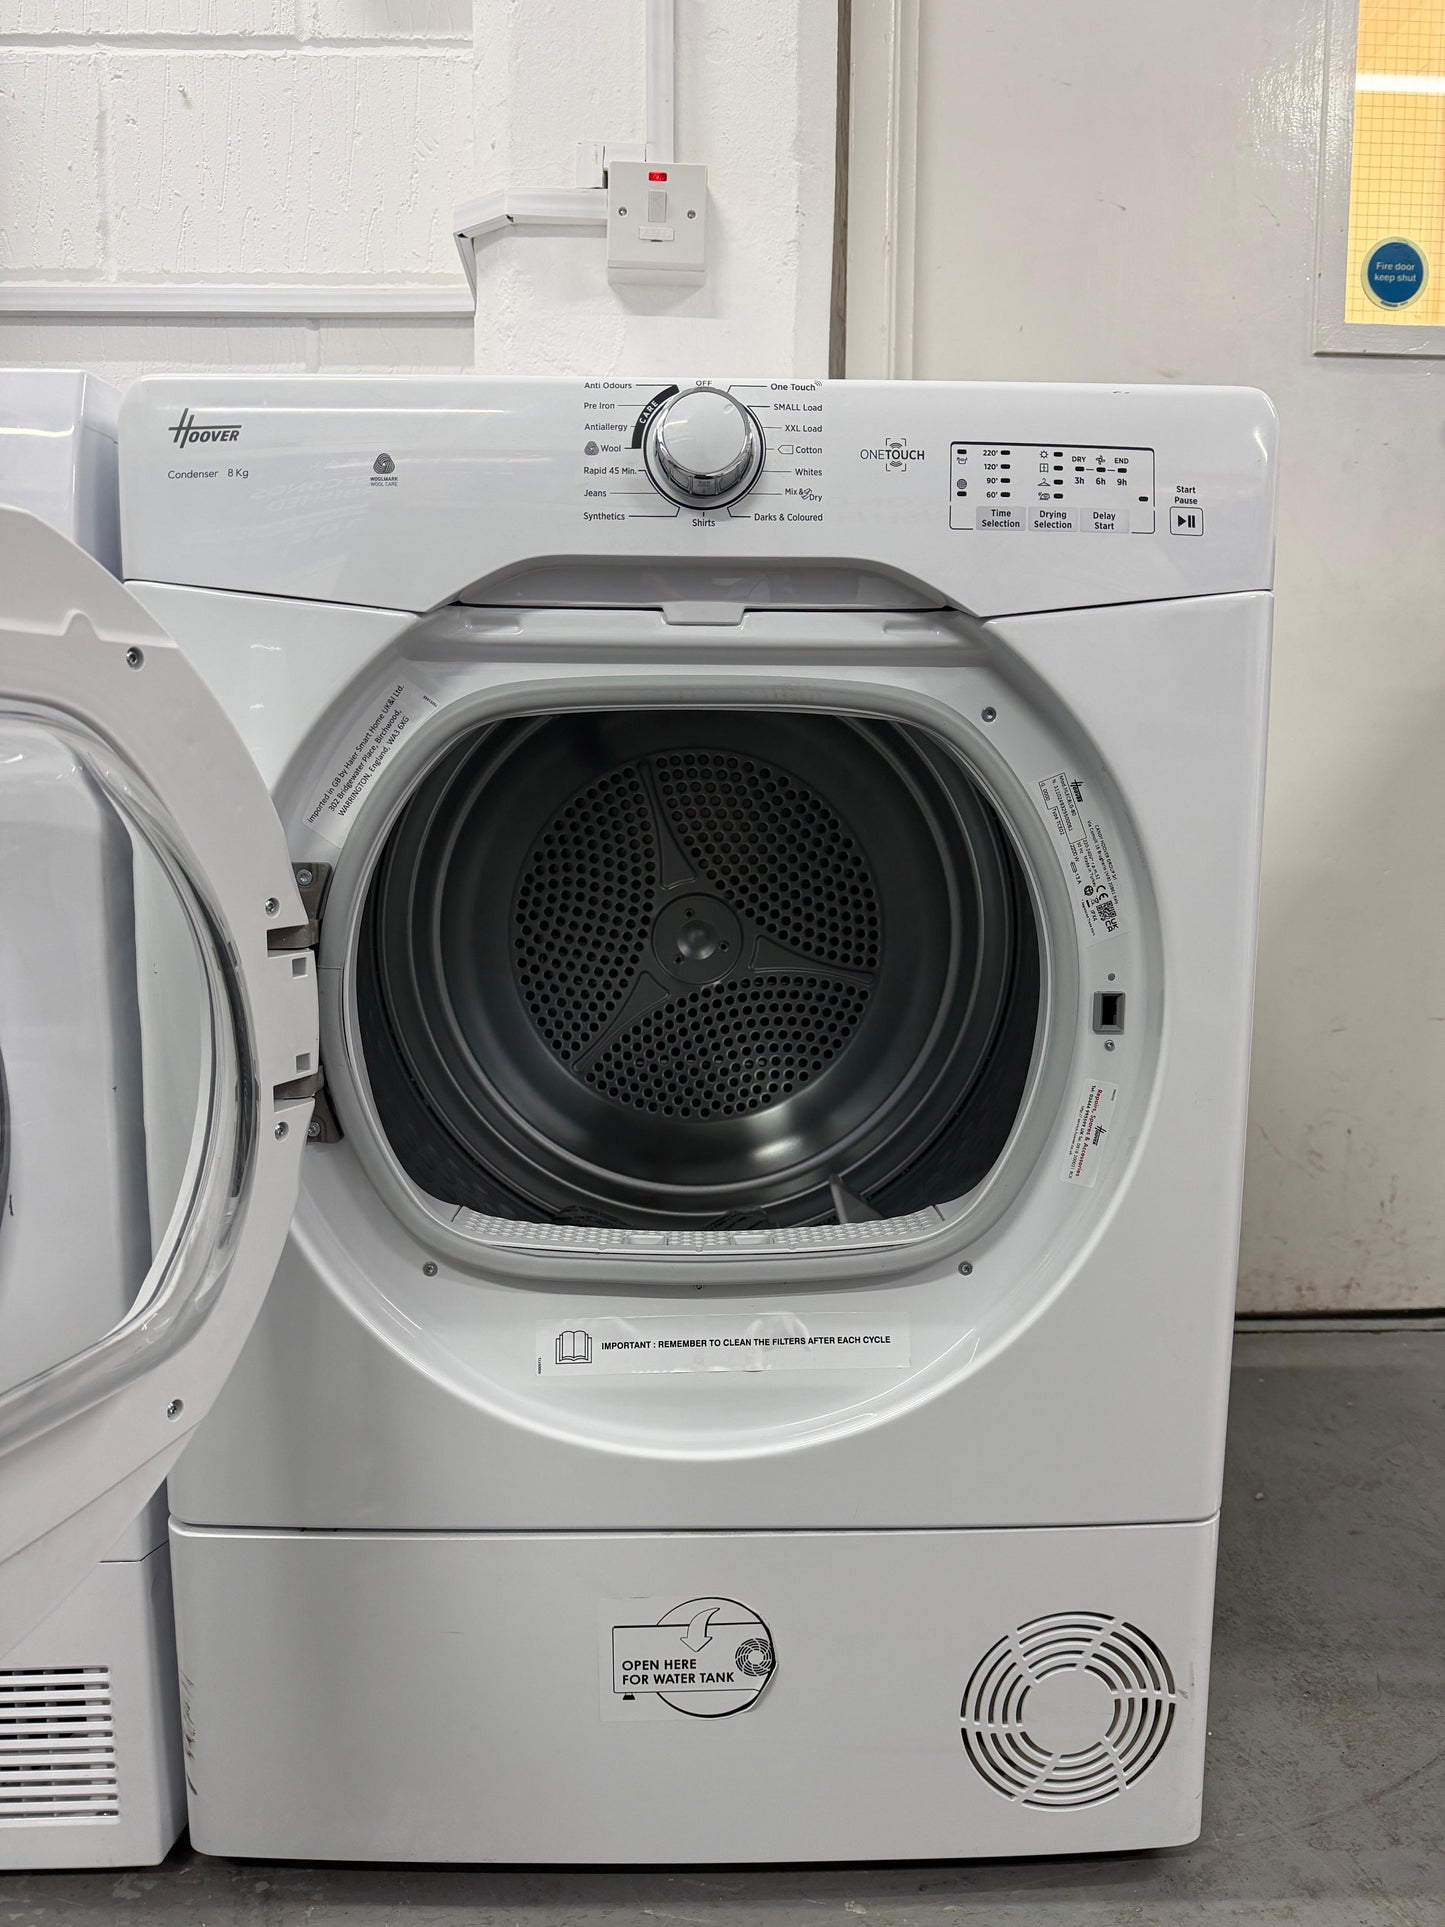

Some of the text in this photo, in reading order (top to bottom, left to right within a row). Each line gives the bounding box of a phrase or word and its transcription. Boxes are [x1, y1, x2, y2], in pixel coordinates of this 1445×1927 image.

[1376, 262, 1415, 271] Fire door
[1374, 273, 1416, 283] keep shut
[770, 383, 816, 392] One Touch
[640, 400, 658, 424] CARE
[168, 408, 242, 448] HOOVER
[584, 423, 628, 432] Antiallergy
[600, 444, 622, 452] Wool
[796, 446, 822, 454] Cotton
[860, 449, 925, 460] ONETOUCH
[168, 468, 249, 480] Condenser 8 Kg
[584, 466, 606, 475] Rapid
[794, 468, 822, 476] Whites
[1074, 476, 1128, 486] 3h 6h 9h
[584, 490, 607, 498] Jeans
[1176, 486, 1196, 494] Start
[809, 494, 822, 502] Dry
[1174, 496, 1198, 505] Pause
[584, 512, 626, 520] Synthetics
[787, 514, 823, 522] Coloured
[990, 508, 1012, 518] Time
[1039, 510, 1067, 520] Drying
[1092, 512, 1116, 521] Delay
[692, 518, 716, 526] Shirts
[982, 520, 1020, 528] Selection
[1034, 520, 1072, 530] Selection
[1094, 522, 1114, 530] Start
[306, 684, 405, 823] Imported in GB by Haier Smart Home UK&I Ltd.
[328, 710, 402, 812] 302 Bridgewater Place, Birchwood,
[338, 716, 410, 817] WARRINGTON, England, WA3 6XG
[1096, 885, 1108, 900] CE
[1085, 1114, 1096, 1136] Spares
[1075, 1143, 1089, 1177] Accessories
[602, 1340, 652, 1350] IMPORTANT
[658, 1340, 707, 1348] REMEMBER
[708, 1339, 721, 1347] TO
[722, 1338, 752, 1347] CLEAN
[754, 1338, 770, 1346] THE
[772, 1337, 806, 1346] FILTERS
[808, 1336, 836, 1344] AFTER
[838, 1336, 860, 1344] EACH
[862, 1336, 891, 1344] CYCLE
[622, 1658, 697, 1671] OPEN HERE
[622, 1672, 735, 1685] FOR WATER TANK
